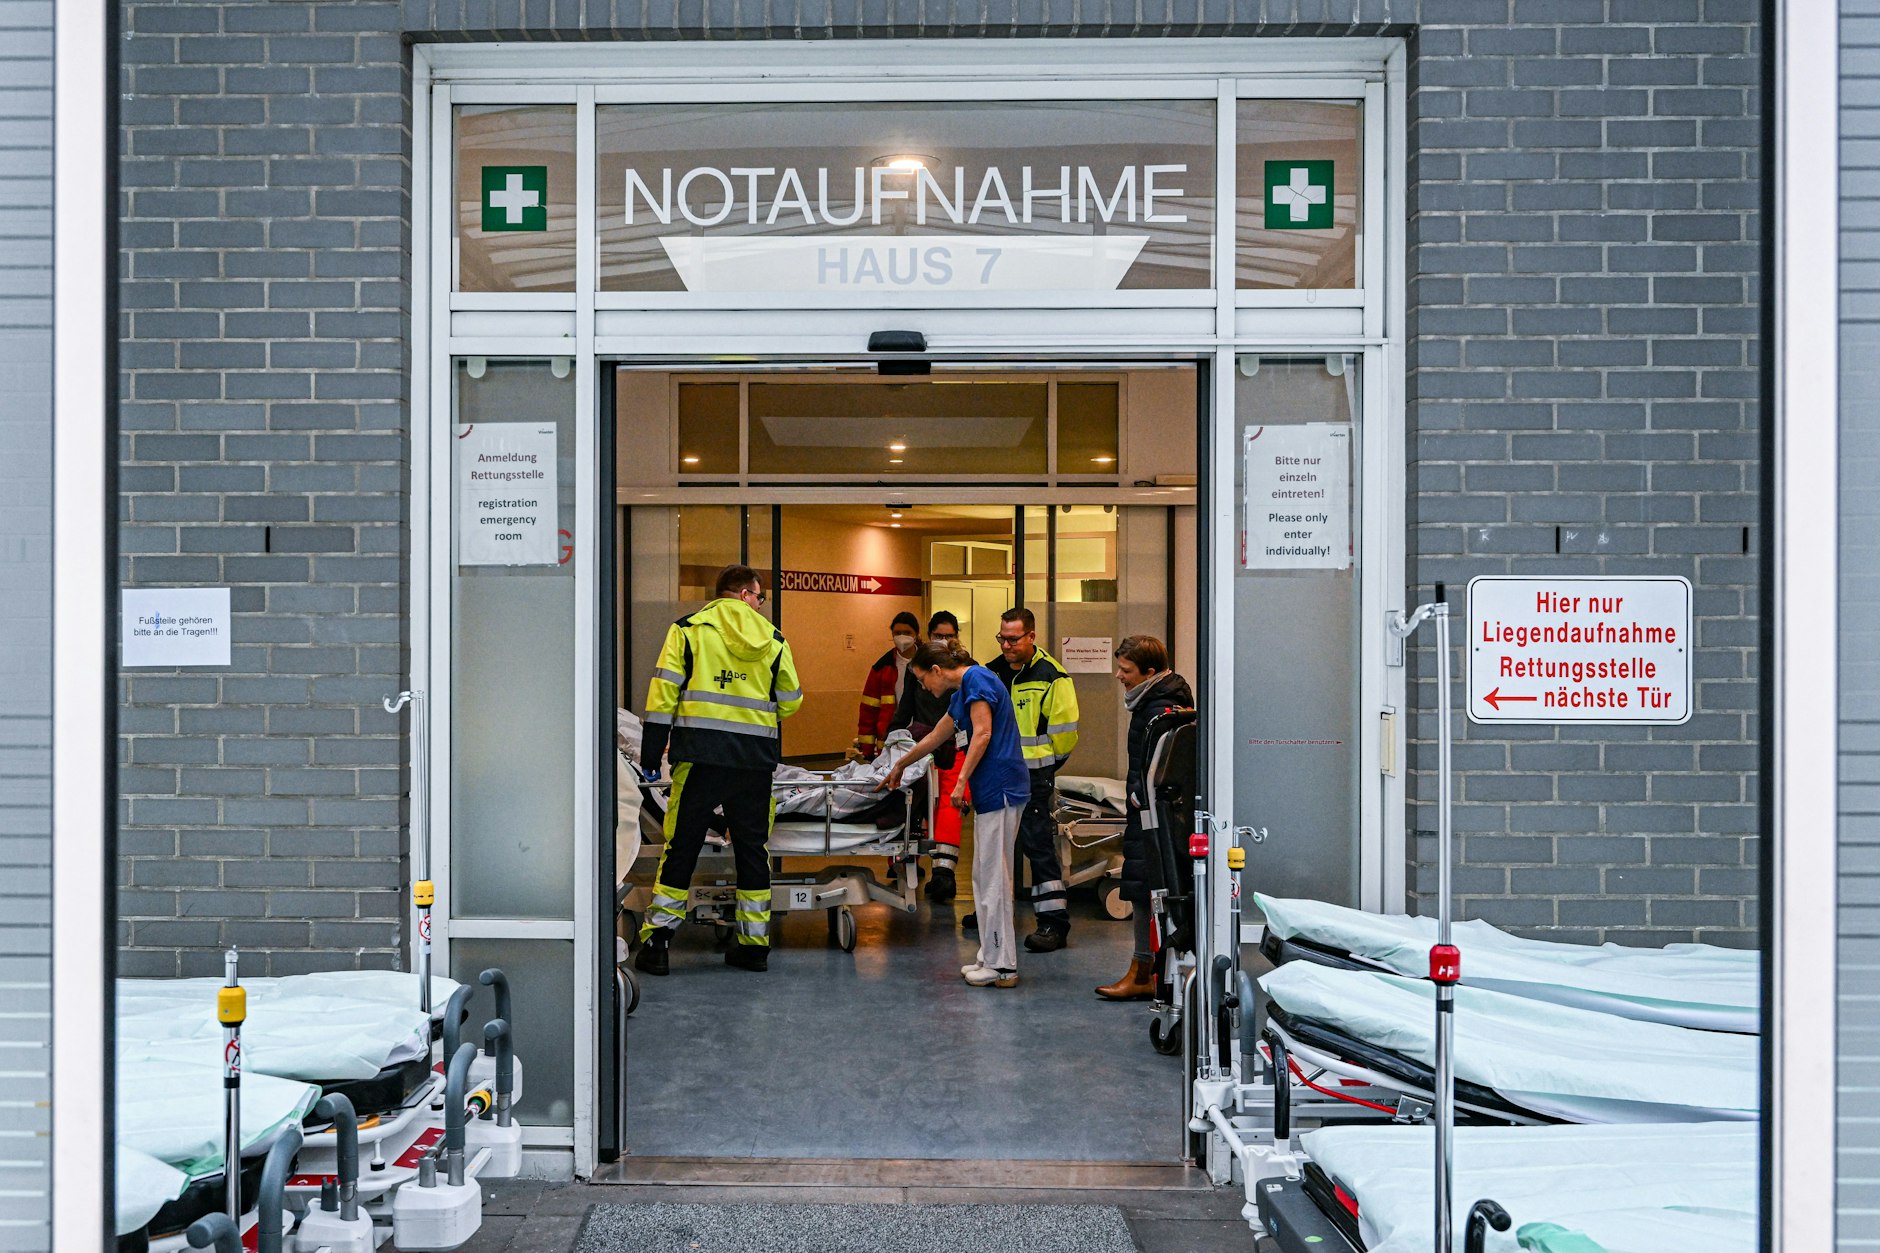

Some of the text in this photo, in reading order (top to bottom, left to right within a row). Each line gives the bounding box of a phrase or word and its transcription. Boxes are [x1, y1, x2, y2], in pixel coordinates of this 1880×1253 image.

[625, 164, 1187, 226] NOTAUFNAHME
[818, 246, 1002, 285] HAUS 7
[478, 453, 537, 464] Anmeldung
[1275, 456, 1321, 465] Bitte nur
[471, 470, 544, 481] Rettungsstelle
[1279, 472, 1317, 482] einzeln
[1271, 489, 1325, 499] eintreten!
[478, 498, 538, 510] registration
[480, 516, 536, 526] emergency
[1268, 513, 1328, 524] Please only
[494, 533, 522, 541] room
[1284, 531, 1312, 539] enter
[1265, 546, 1330, 557] individually!
[781, 571, 858, 592] SCHOCKRAUM
[1537, 592, 1623, 613] Hier nur
[178, 616, 213, 626] gehören
[133, 628, 151, 636] bitte
[166, 628, 179, 636] die
[181, 627, 218, 637] Tragen!!!
[1483, 621, 1676, 647] Liegendaufnahme
[1500, 656, 1656, 682] Rettungsstelle
[1544, 686, 1672, 708] nächste Tür
[795, 892, 807, 903] 12
